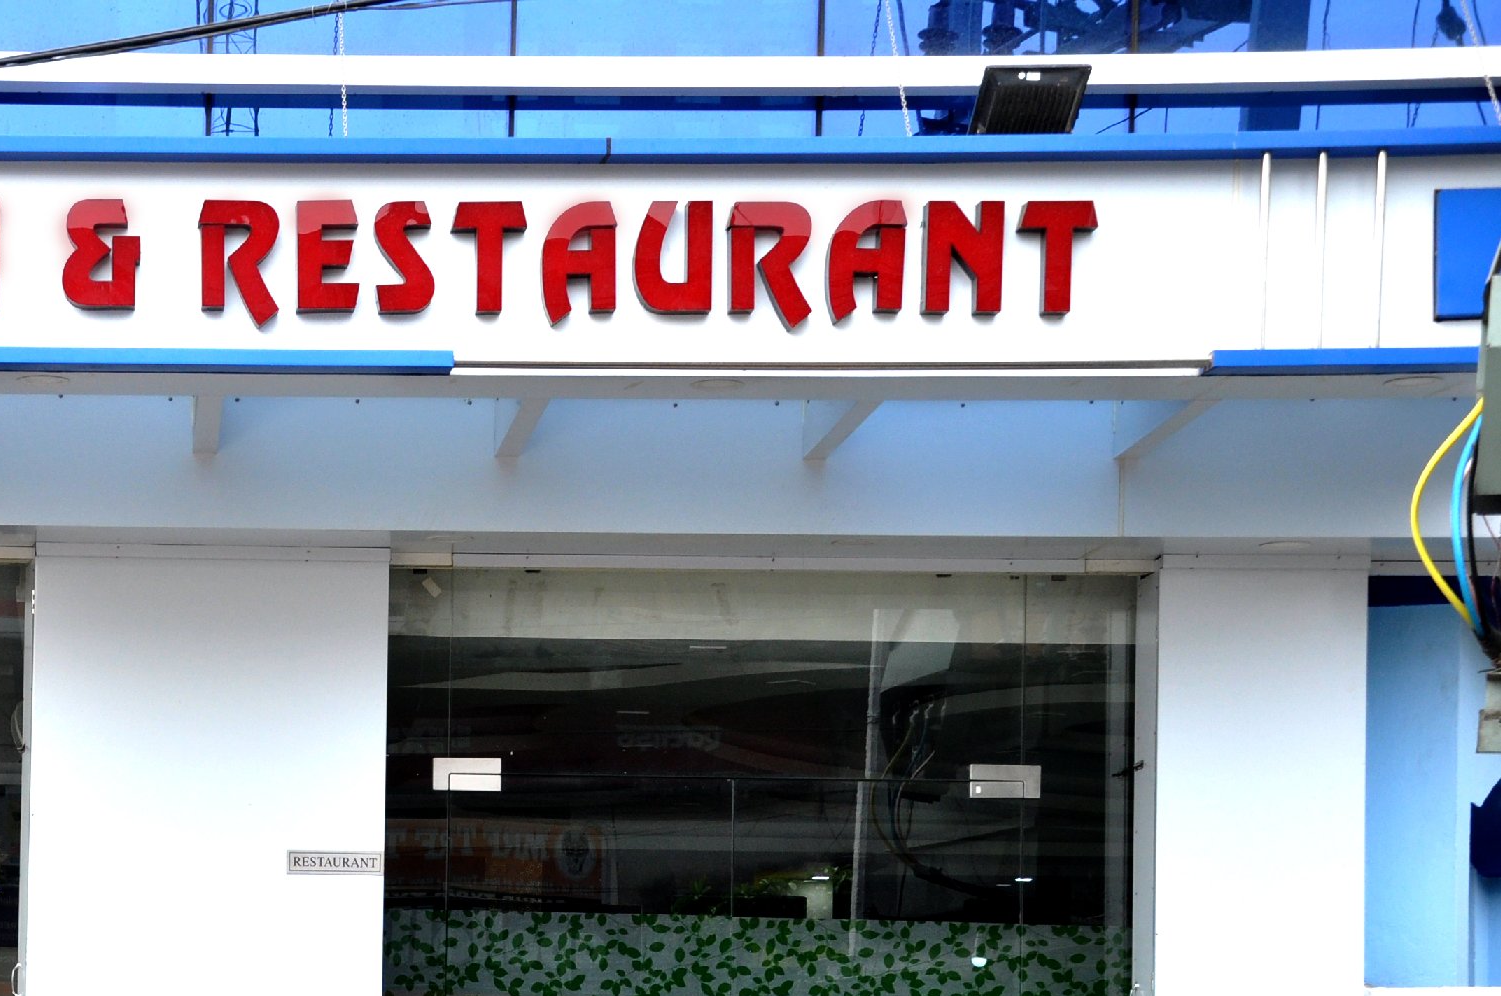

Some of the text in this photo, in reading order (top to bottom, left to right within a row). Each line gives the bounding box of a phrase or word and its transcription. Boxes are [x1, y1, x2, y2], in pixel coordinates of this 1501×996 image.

[62, 199, 140, 312] &
[197, 199, 1098, 330] RESTAURANT
[293, 856, 378, 868] RESTAURANT
